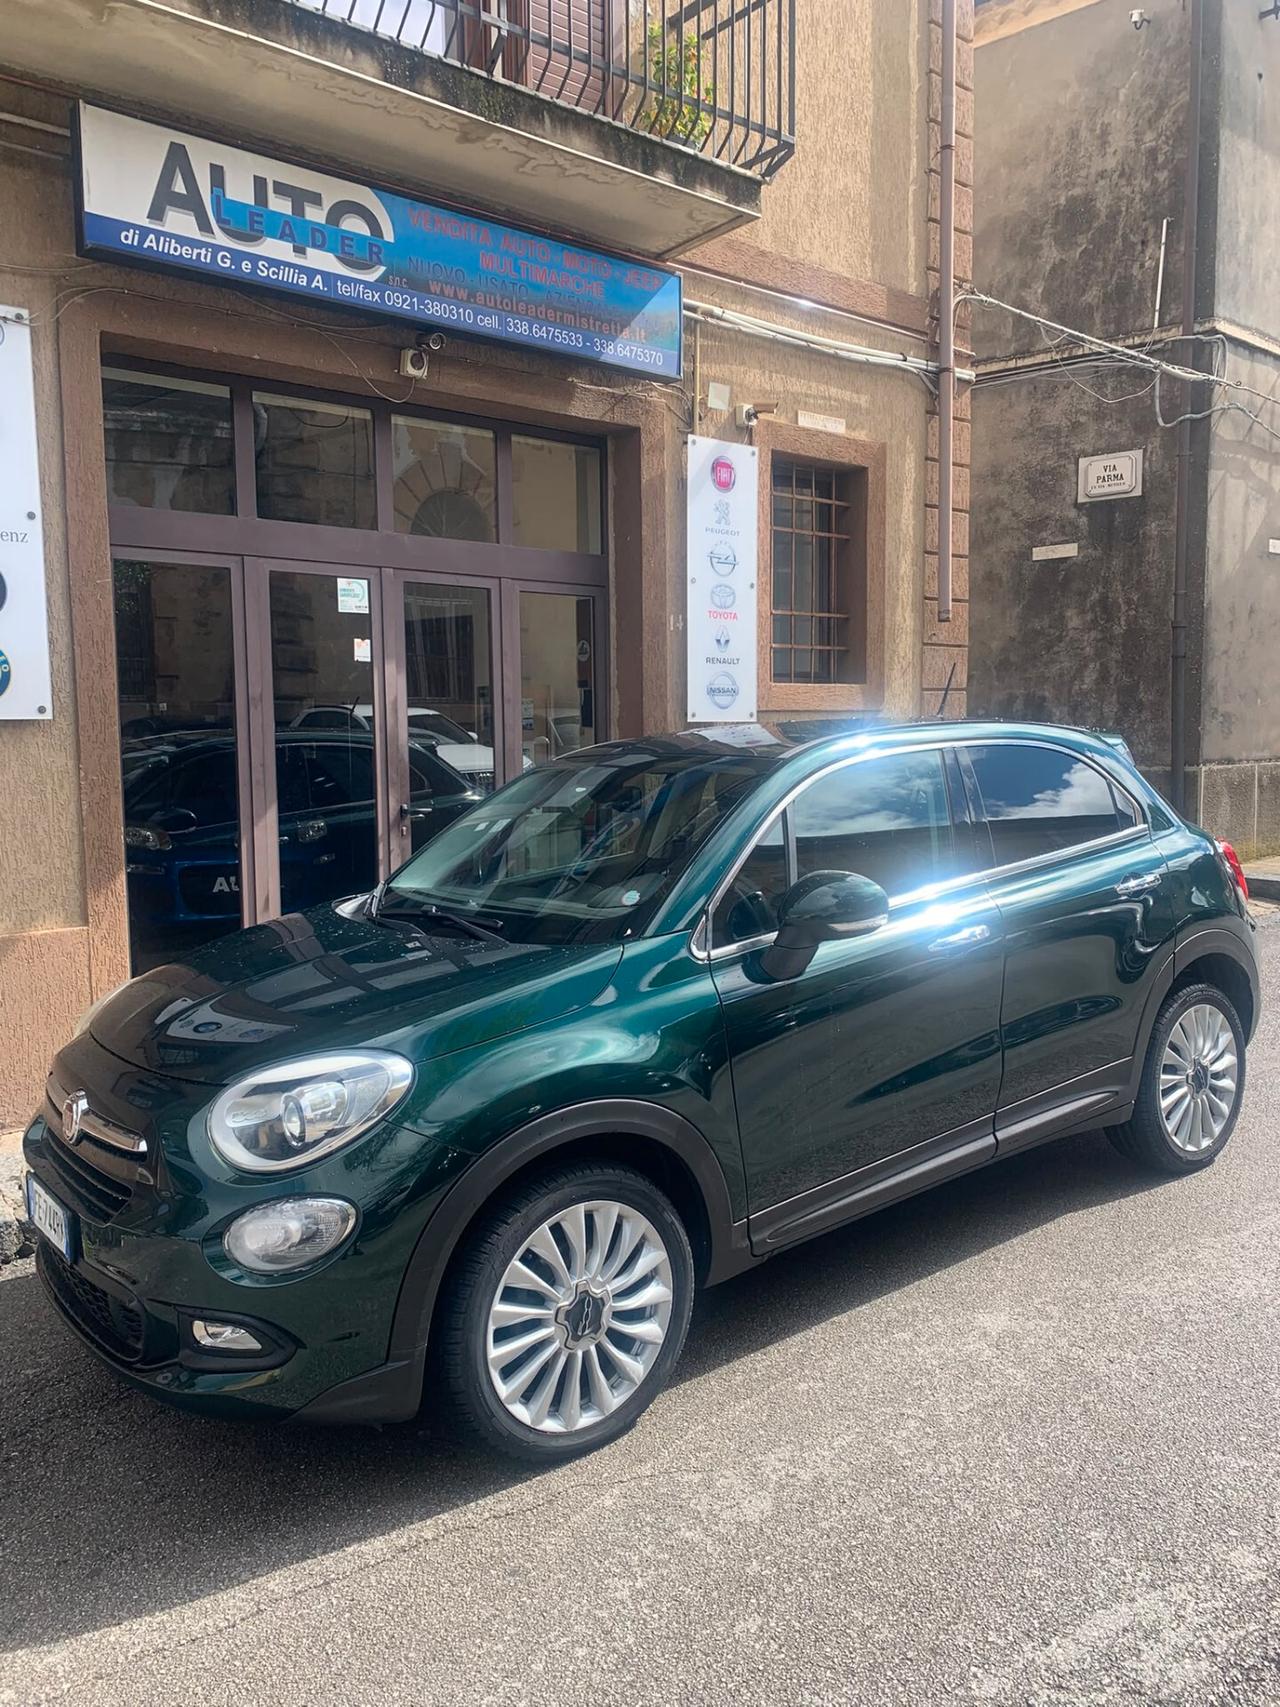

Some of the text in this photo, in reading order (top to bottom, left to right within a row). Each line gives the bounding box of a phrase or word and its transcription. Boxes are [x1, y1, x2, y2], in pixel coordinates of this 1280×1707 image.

[147, 141, 384, 270] AUTO
[213, 190, 385, 265] LEADER
[120, 228, 328, 291] di Aliberti G. e Scillia A.
[408, 207, 492, 246] VENDITA
[502, 234, 551, 263] AUTO
[563, 250, 612, 279] MOTO
[624, 268, 663, 291] JEEP
[408, 255, 465, 283] NUOVO
[479, 273, 529, 299] USATO
[480, 251, 605, 298] MULTIMARCHE
[337, 279, 381, 303] tel/fax
[384, 291, 473, 323] 0921-380310
[477, 314, 501, 330] cell.
[506, 317, 583, 347] 338.6475533
[594, 338, 663, 366] 338.6475370
[429, 279, 646, 342] www.autoleadermistretta.it
[716, 466, 732, 484] FIAT
[1096, 473, 1124, 483] PARMA
[1103, 464, 1117, 472] VIA
[705, 527, 740, 536] PEUGEOT
[708, 610, 738, 621] TOYOTA
[705, 656, 741, 665] RENAULT
[708, 686, 737, 695] NISSAN
